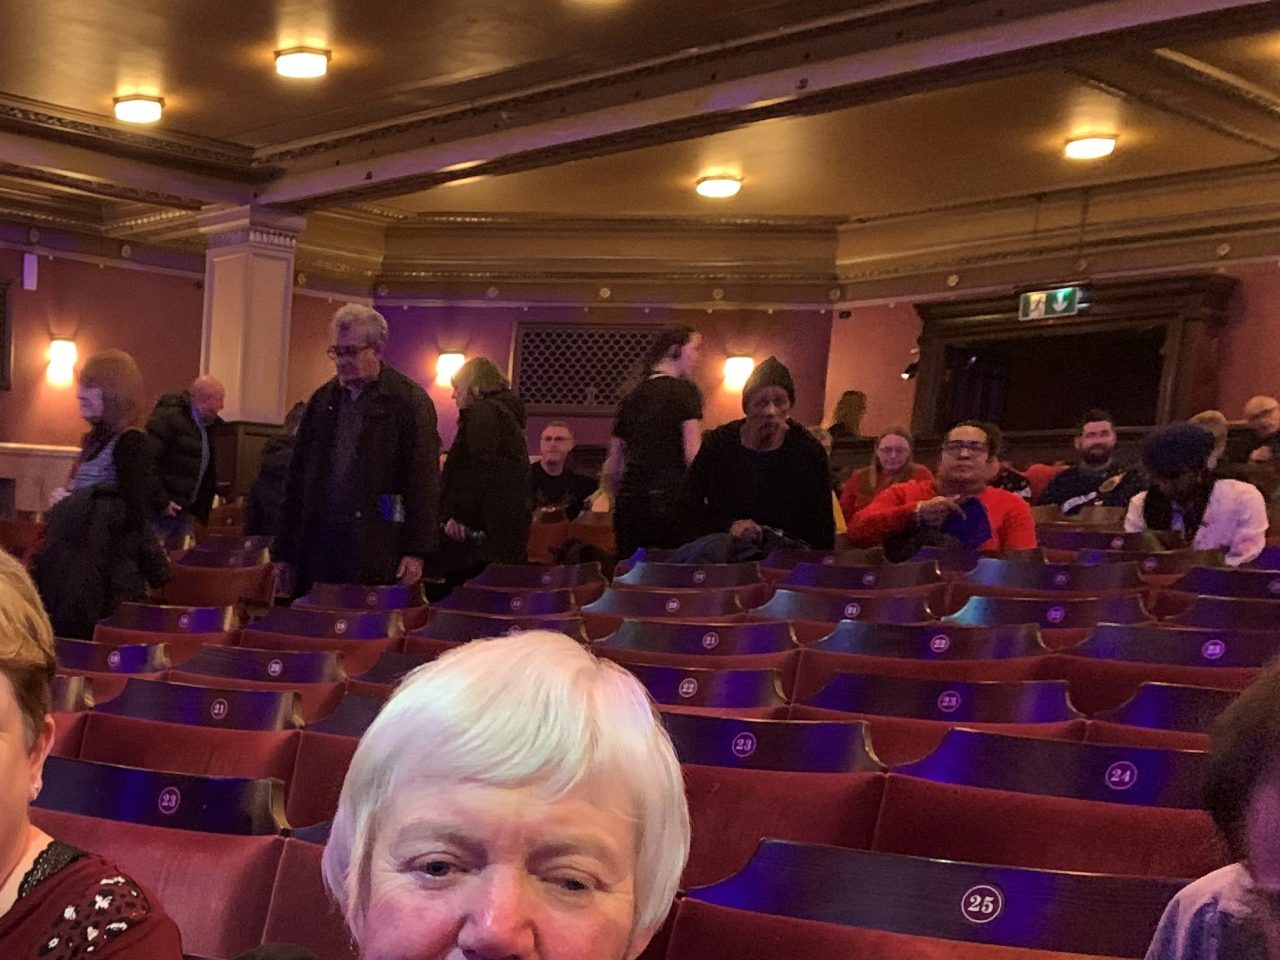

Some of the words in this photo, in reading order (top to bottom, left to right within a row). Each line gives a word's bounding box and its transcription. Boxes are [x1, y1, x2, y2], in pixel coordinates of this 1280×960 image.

[706, 636, 715, 644] 21
[934, 639, 946, 648] 22
[682, 682, 694, 693] 22
[942, 696, 957, 706] 23
[213, 703, 224, 714] 21
[736, 738, 752, 751] 23
[1110, 768, 1131, 782] 24
[162, 793, 177, 808] 23
[967, 894, 995, 914] 25
